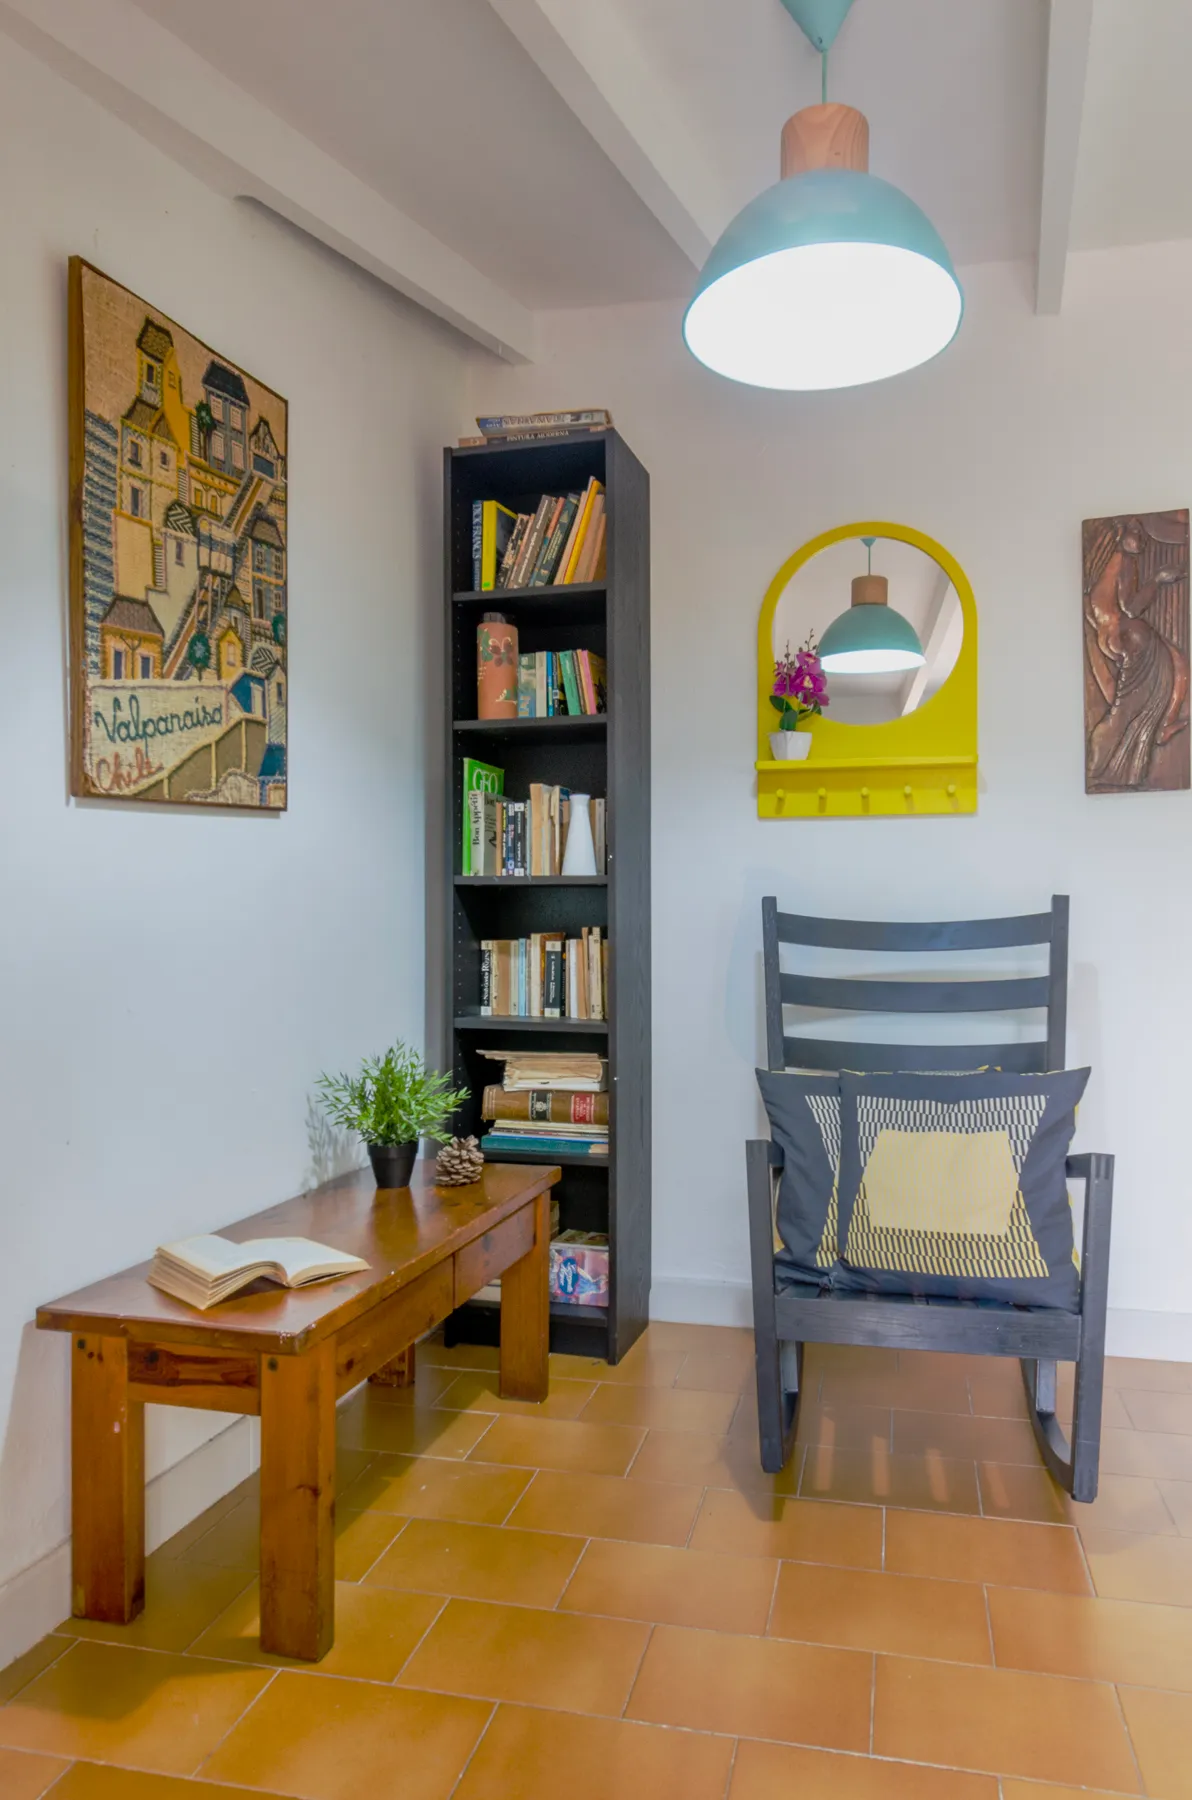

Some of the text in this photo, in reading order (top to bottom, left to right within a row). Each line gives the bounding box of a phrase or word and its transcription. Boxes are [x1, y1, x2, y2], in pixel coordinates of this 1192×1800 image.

[507, 430, 569, 442] PINTURA MODERNA
[473, 503, 481, 559] DICK FRANCIS
[94, 694, 222, 758] Valparaiso
[96, 747, 164, 791] Chile
[473, 768, 498, 794] GEO
[472, 826, 480, 846] Bon
